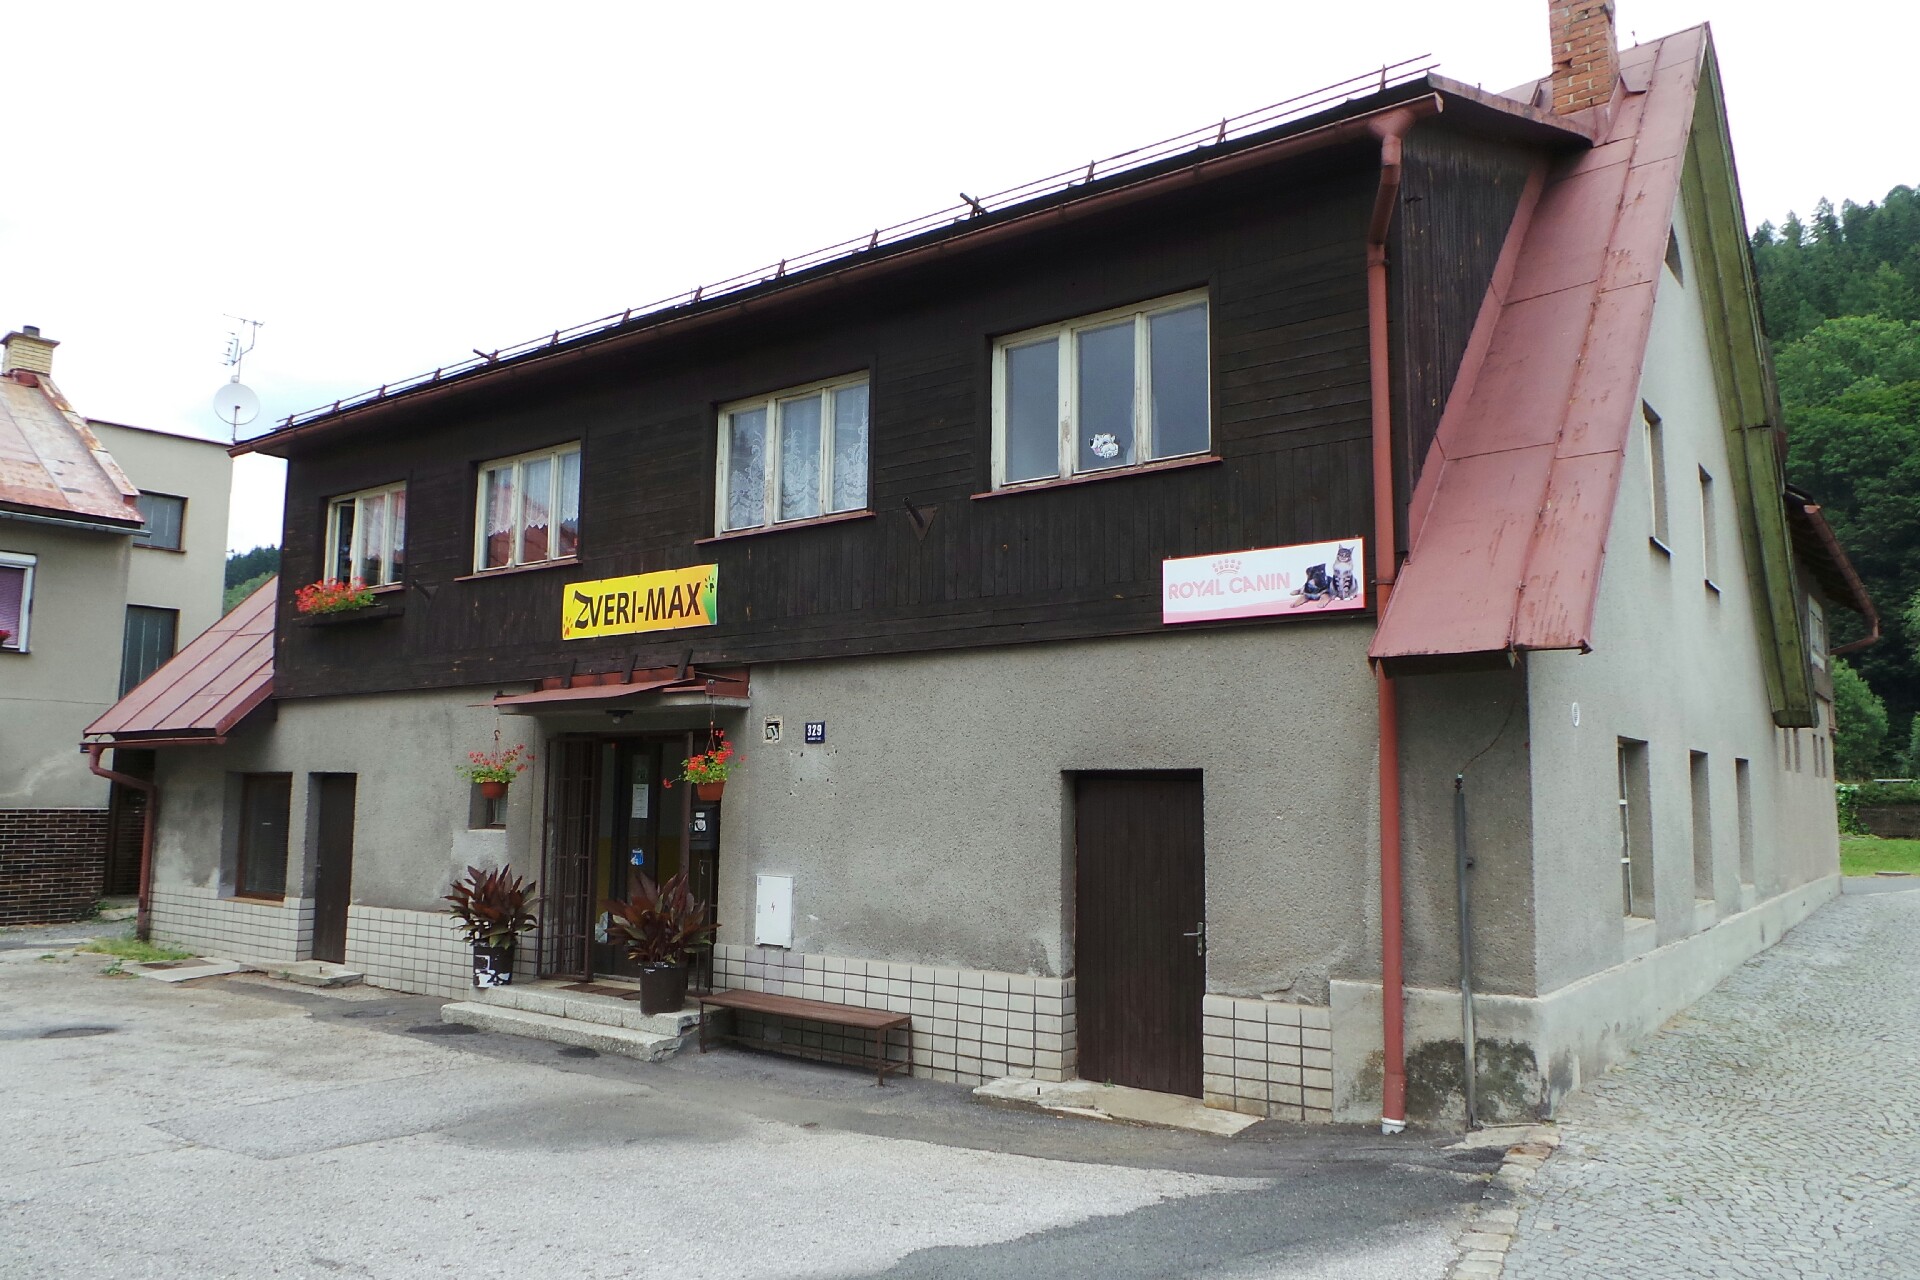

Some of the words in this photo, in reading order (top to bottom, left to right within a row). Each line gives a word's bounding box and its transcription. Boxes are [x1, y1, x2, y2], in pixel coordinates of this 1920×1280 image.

[1168, 579, 1225, 600] ROYAL
[1229, 572, 1291, 594] CANIN
[573, 582, 701, 629] ZVERI-MAX
[807, 724, 822, 736] 329
